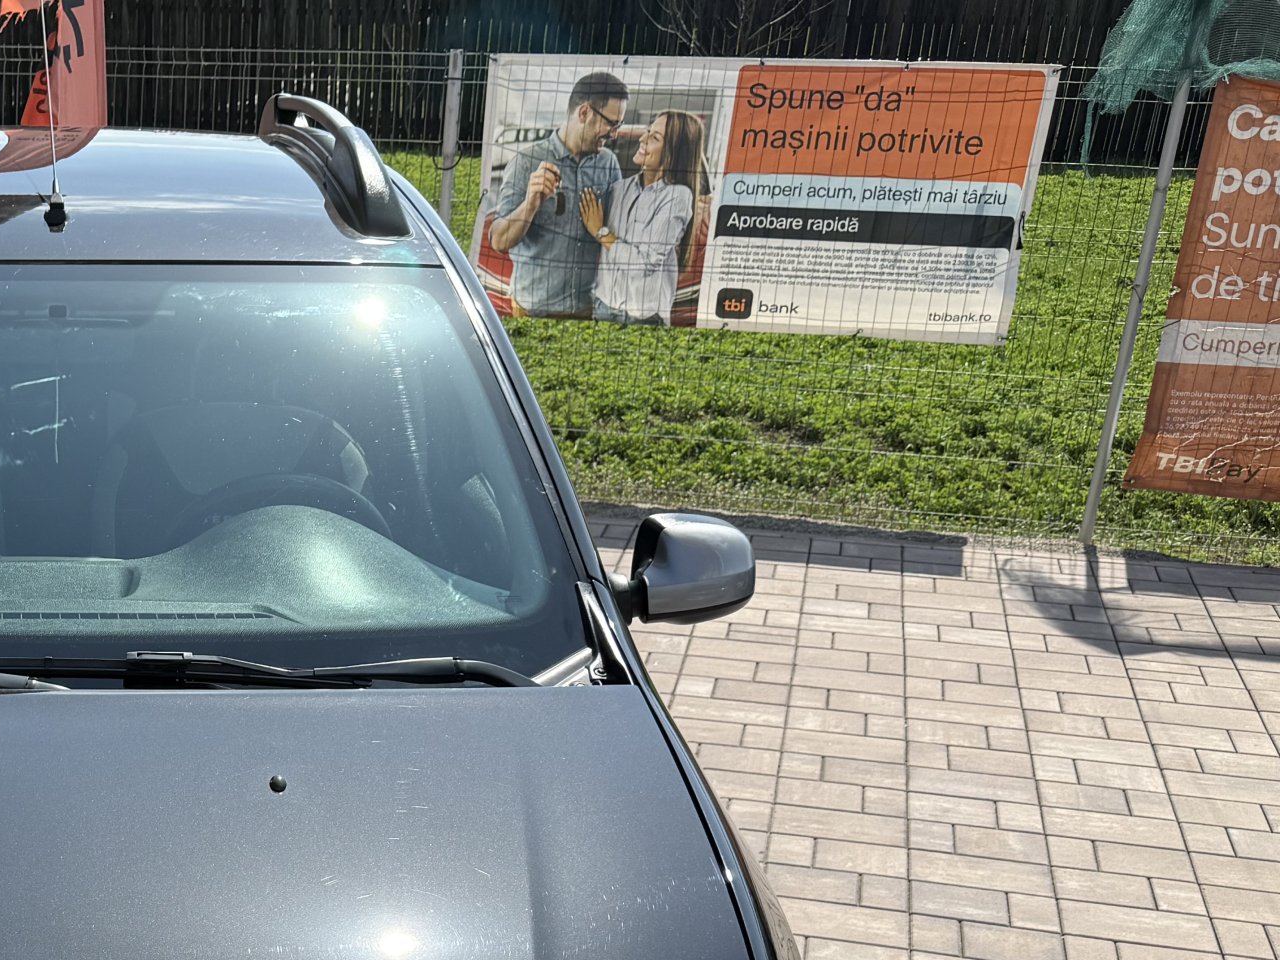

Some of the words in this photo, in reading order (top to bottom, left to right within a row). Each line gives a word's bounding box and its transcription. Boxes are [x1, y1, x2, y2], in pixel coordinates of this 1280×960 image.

[747, 83, 844, 114] Spune
[855, 85, 915, 112] "da"
[741, 124, 849, 156] mașinii
[857, 127, 983, 158] potrivite
[733, 180, 803, 201] Cumperi
[807, 185, 856, 201] acum,
[862, 185, 922, 206] plătești
[926, 188, 957, 204] mai
[963, 189, 1007, 206] târziu
[727, 212, 803, 231] Aprobare
[807, 215, 859, 234] rapidă
[1202, 212, 1280, 249] Sun
[1191, 265, 1244, 300] de
[723, 298, 746, 313] tbi
[758, 300, 799, 315] bank
[928, 312, 992, 323] tbibank.ro
